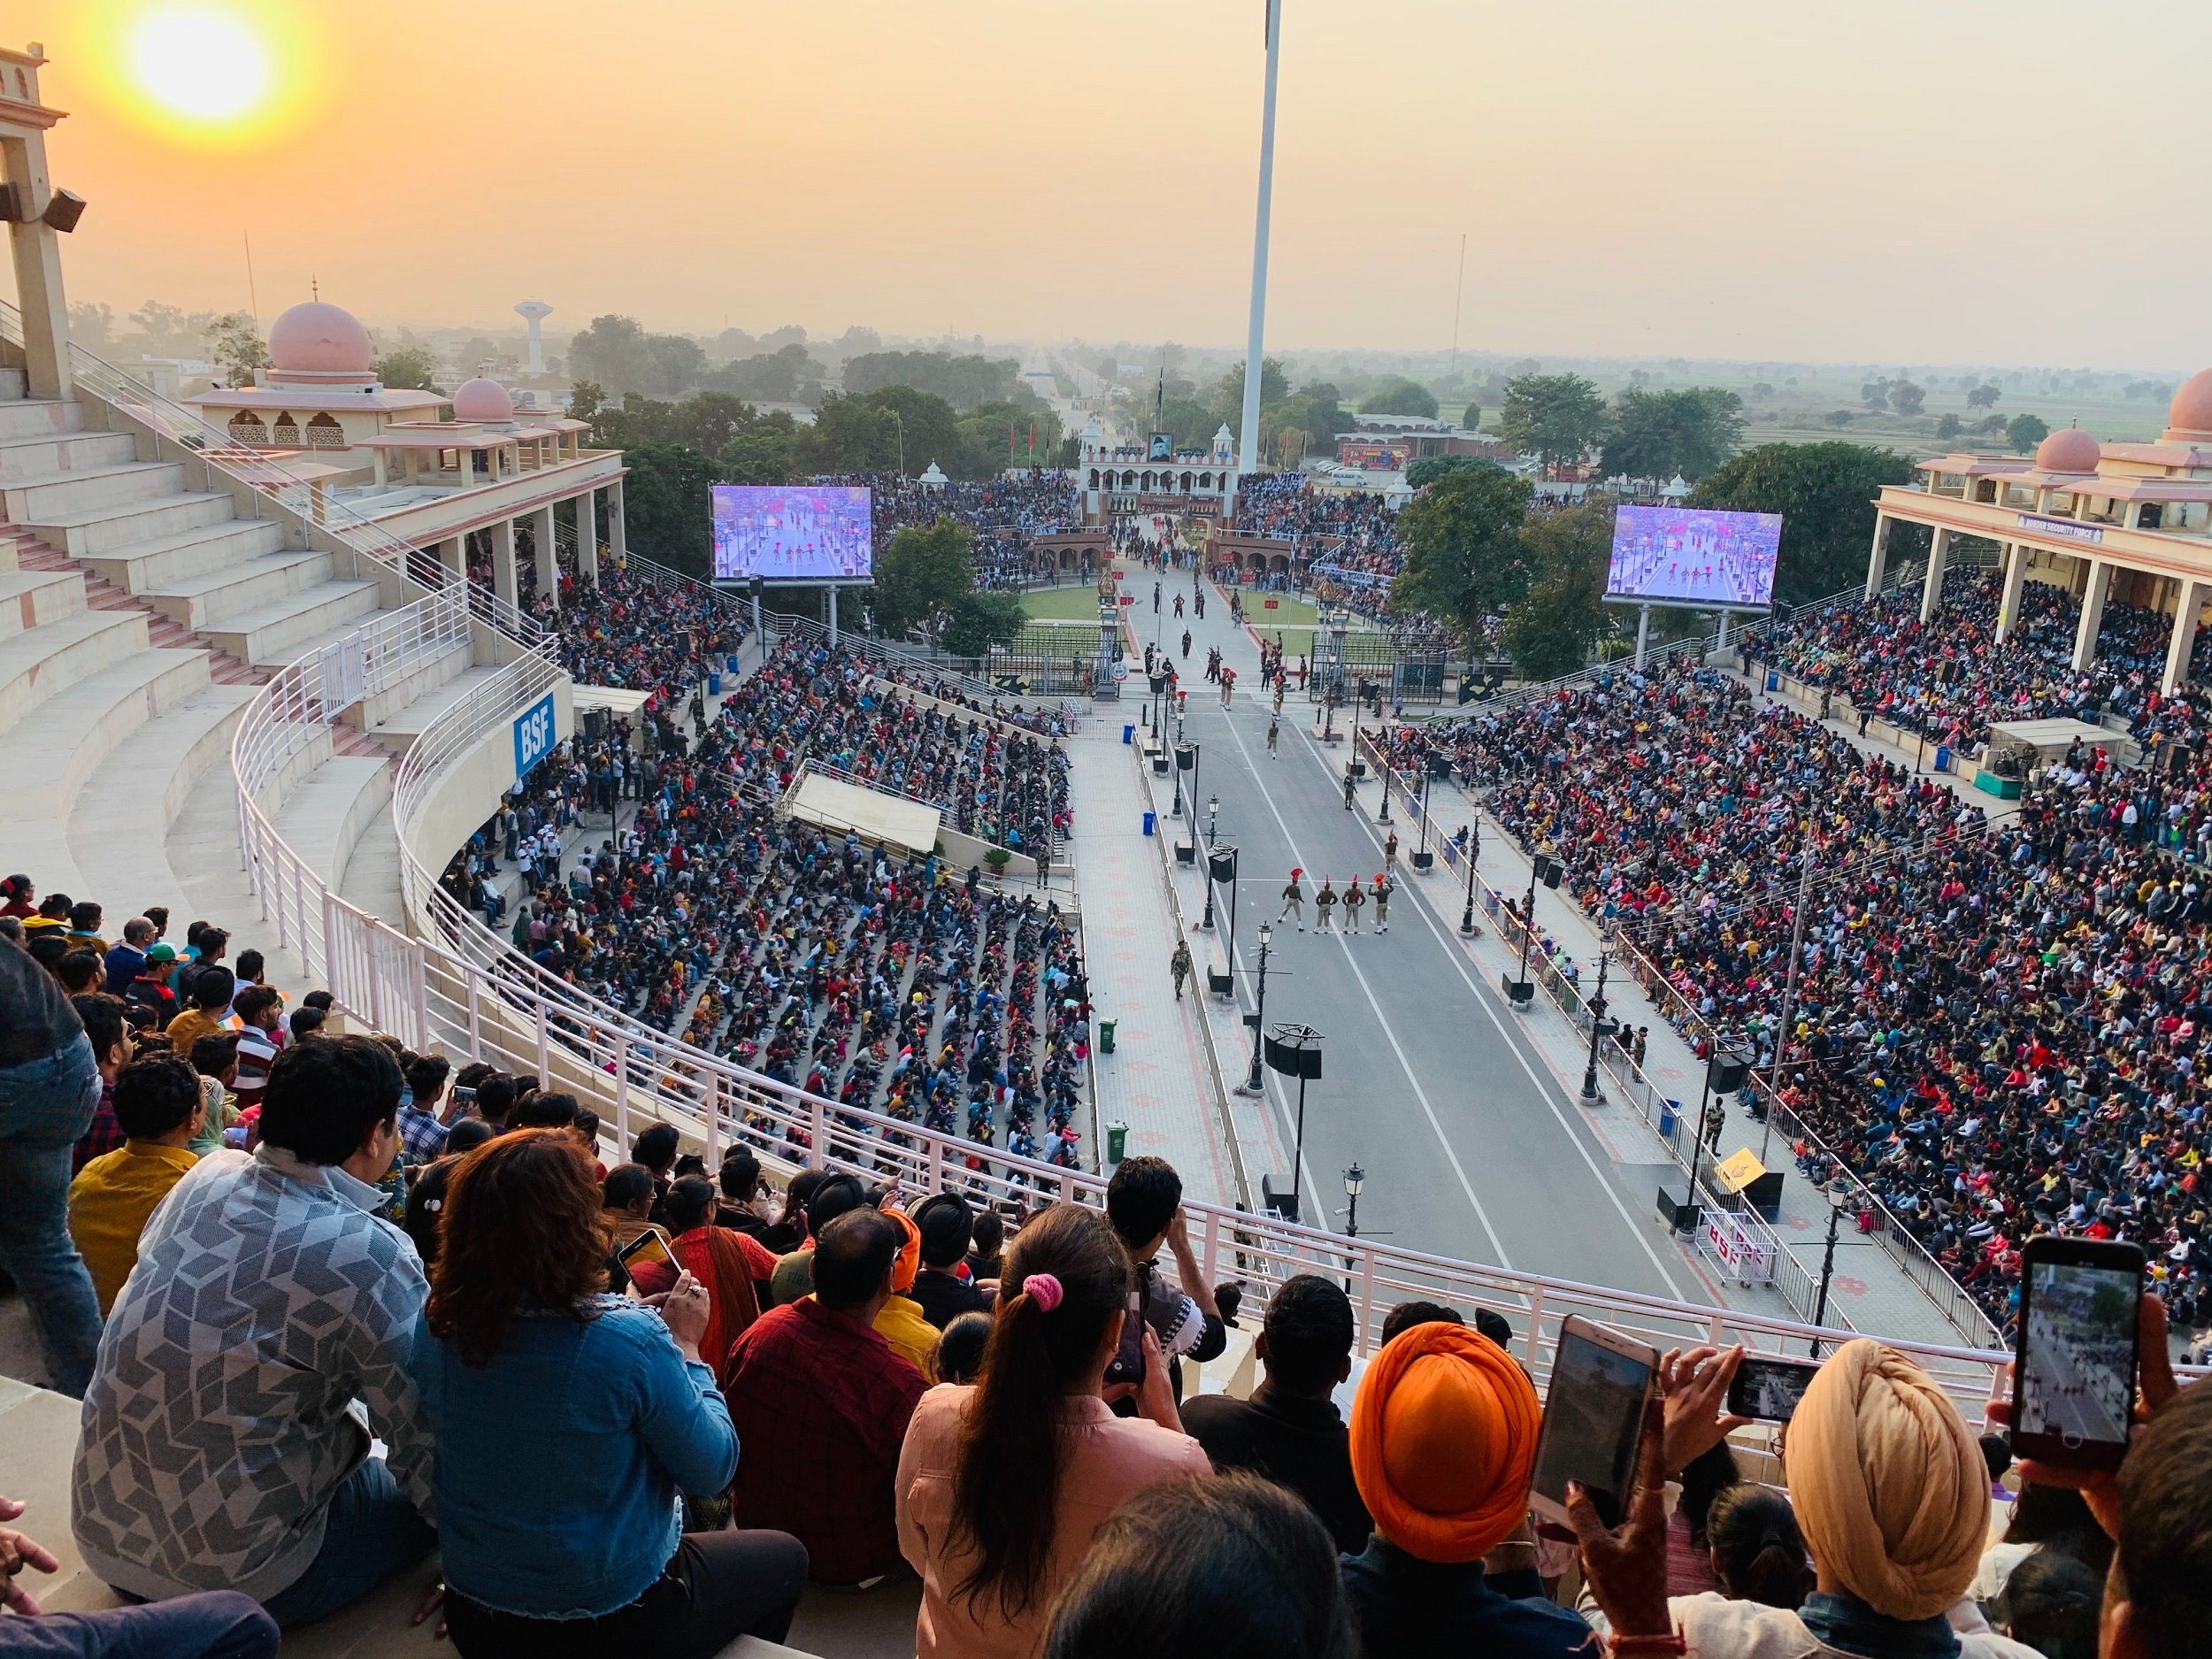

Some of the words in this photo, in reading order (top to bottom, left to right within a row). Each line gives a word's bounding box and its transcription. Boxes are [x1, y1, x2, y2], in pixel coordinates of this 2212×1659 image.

[2026, 518, 2047, 530] BORDER
[2047, 522, 2074, 534] SECURITY
[2074, 527, 2093, 538] FORCE
[521, 704, 548, 764] BSF
[1709, 1225, 1739, 1264] BSF
